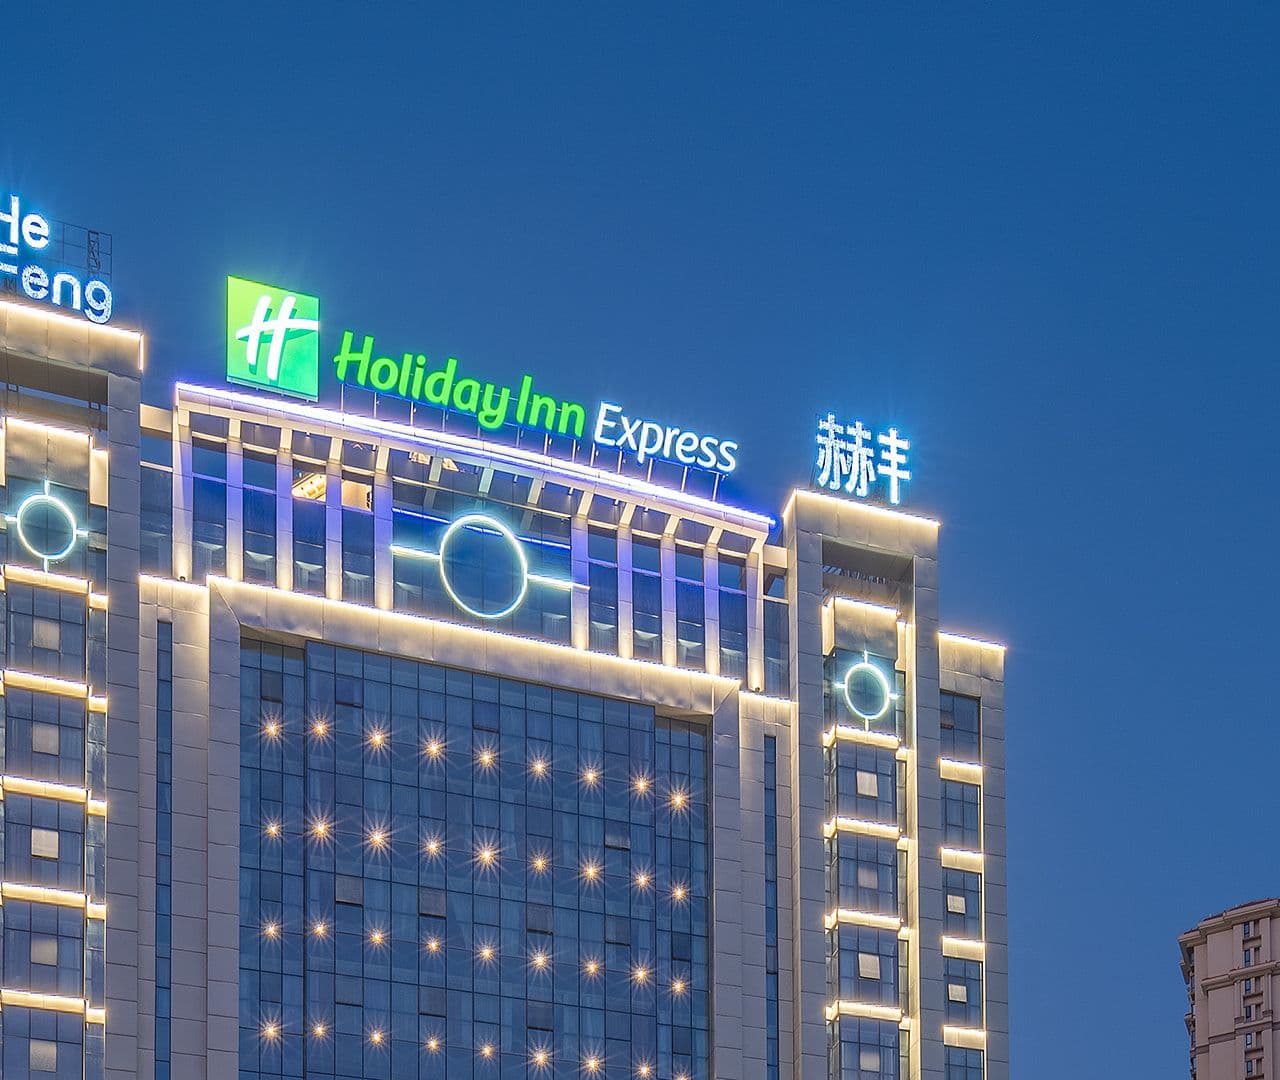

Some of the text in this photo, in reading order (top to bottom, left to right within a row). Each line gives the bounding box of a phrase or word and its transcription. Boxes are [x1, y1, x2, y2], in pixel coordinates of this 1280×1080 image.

[333, 331, 738, 472] Holiday Inn Express
[816, 412, 912, 504] 赫丰
